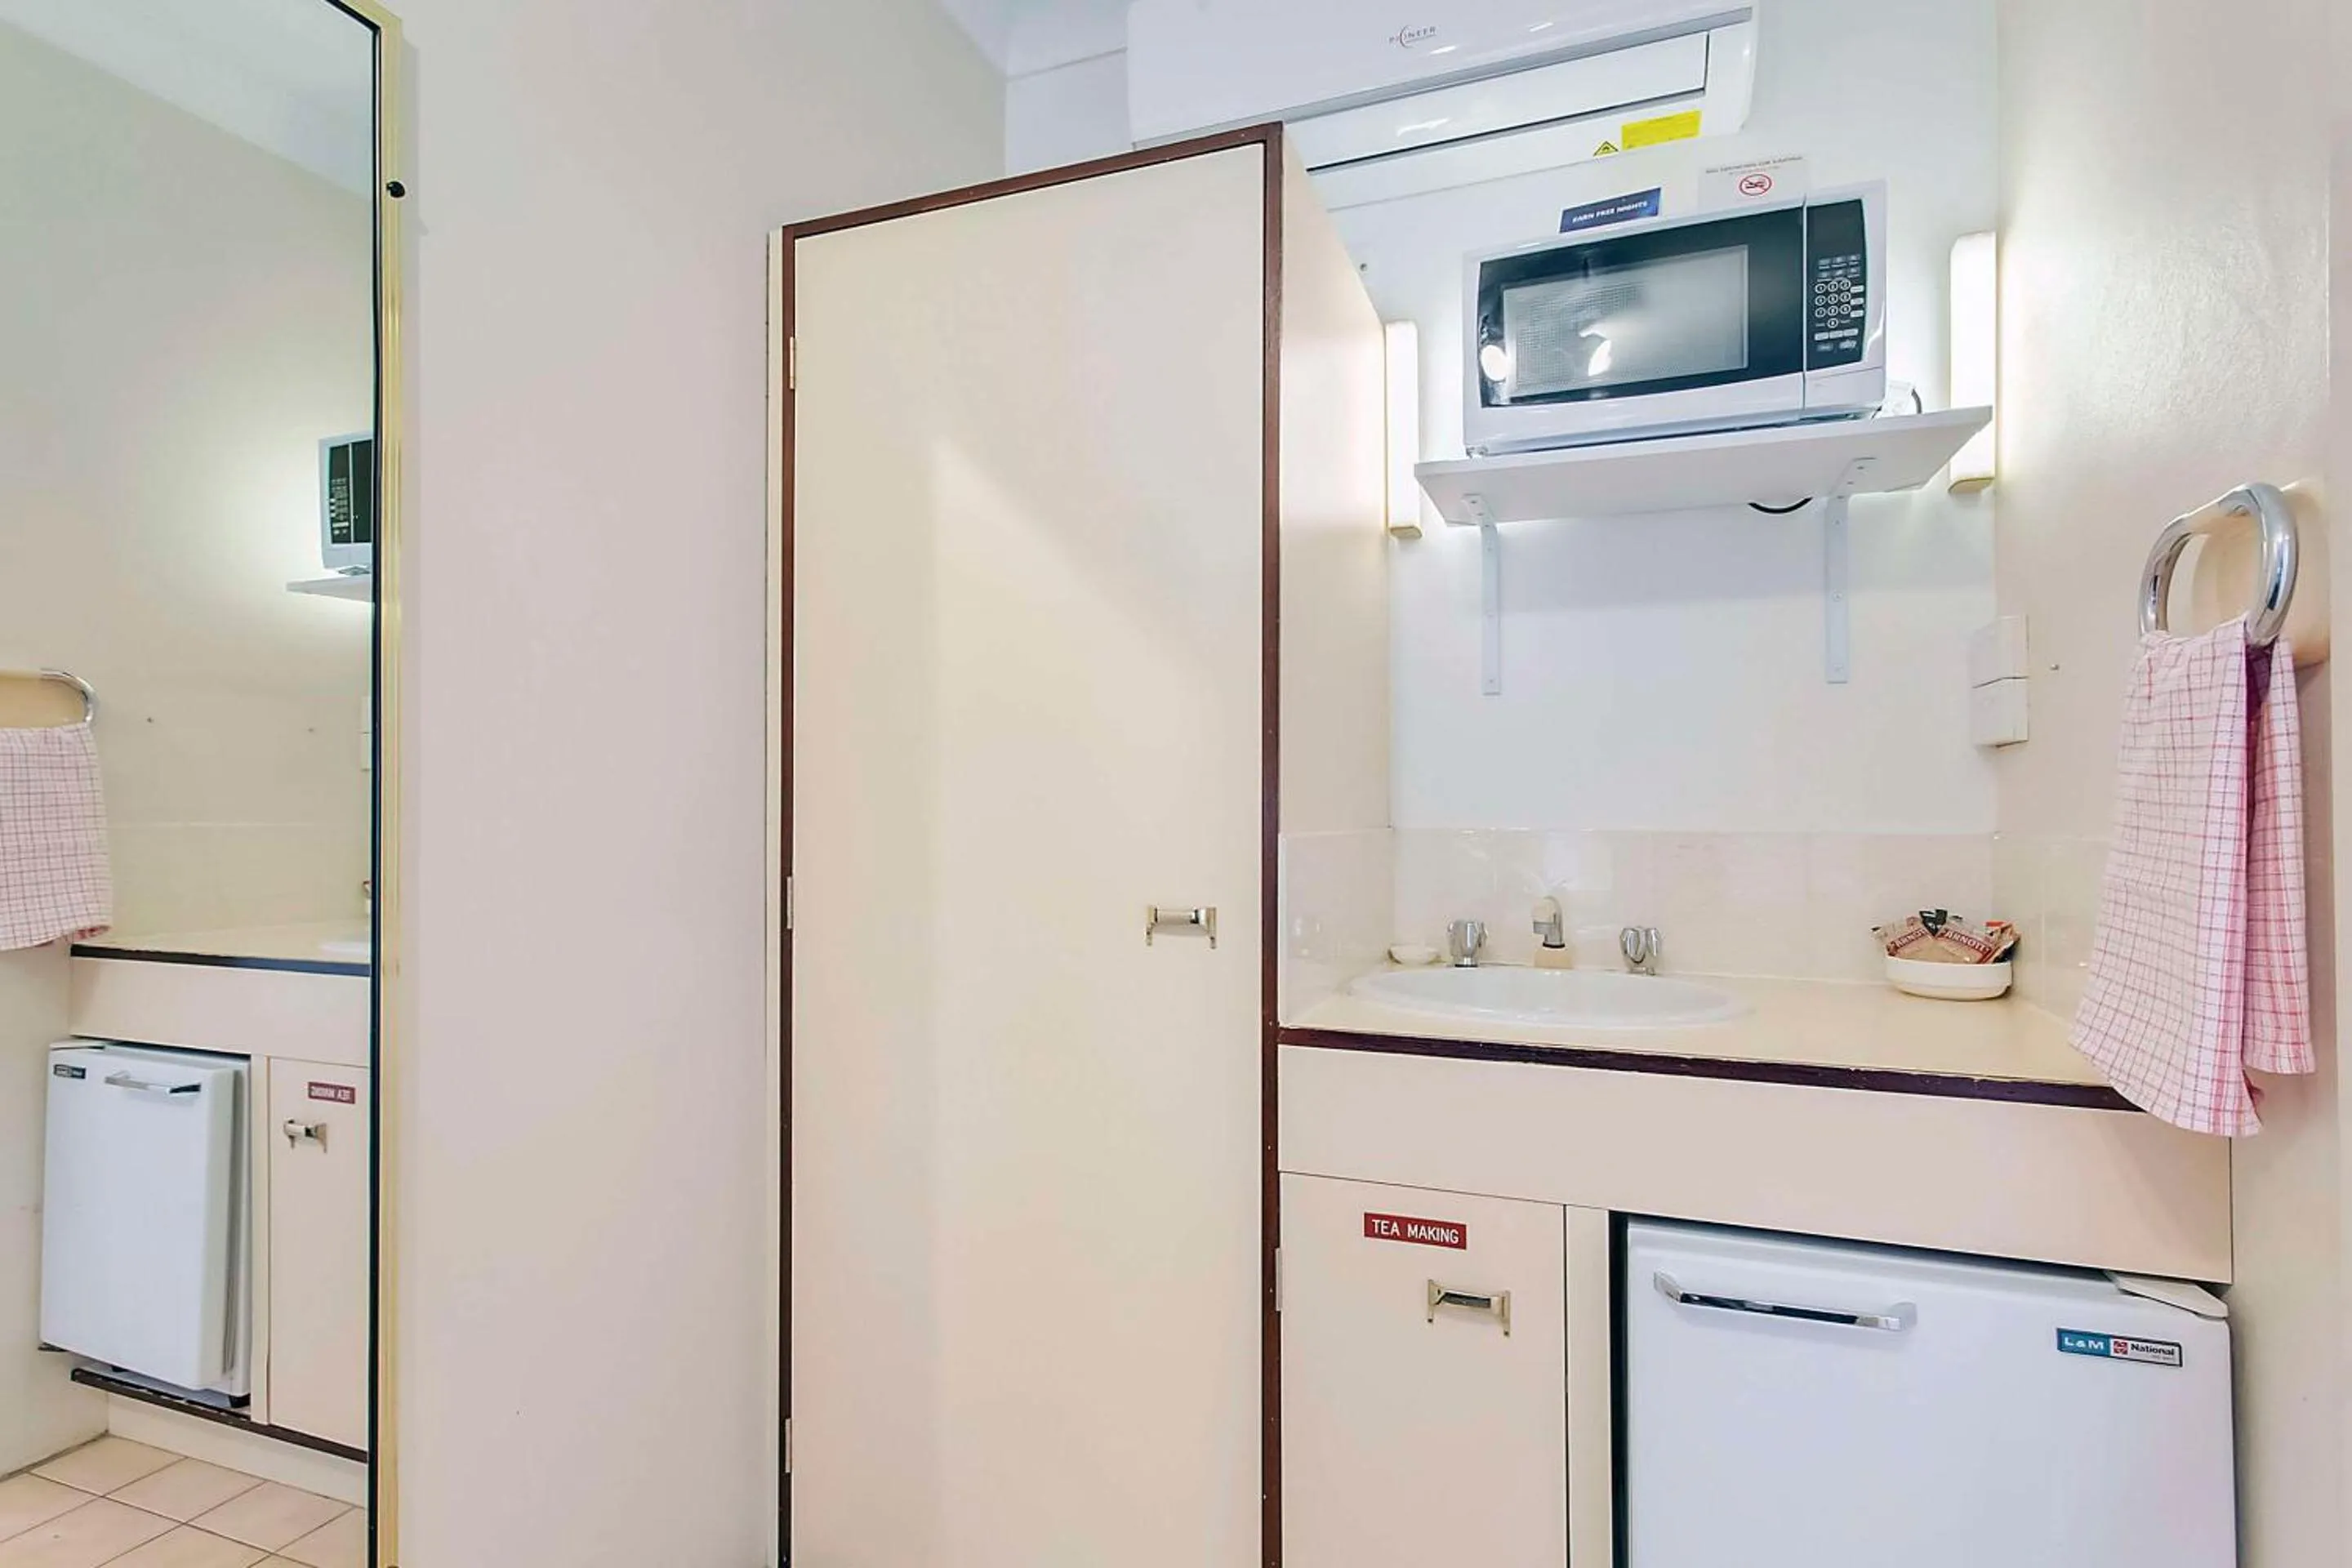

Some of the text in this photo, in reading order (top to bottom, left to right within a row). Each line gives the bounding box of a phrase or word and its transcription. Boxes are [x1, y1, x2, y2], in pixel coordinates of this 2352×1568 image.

[1572, 212, 1594, 224] EARN
[1371, 1218, 1459, 1245] TEA MAKING
[2130, 1343, 2175, 1356] National
